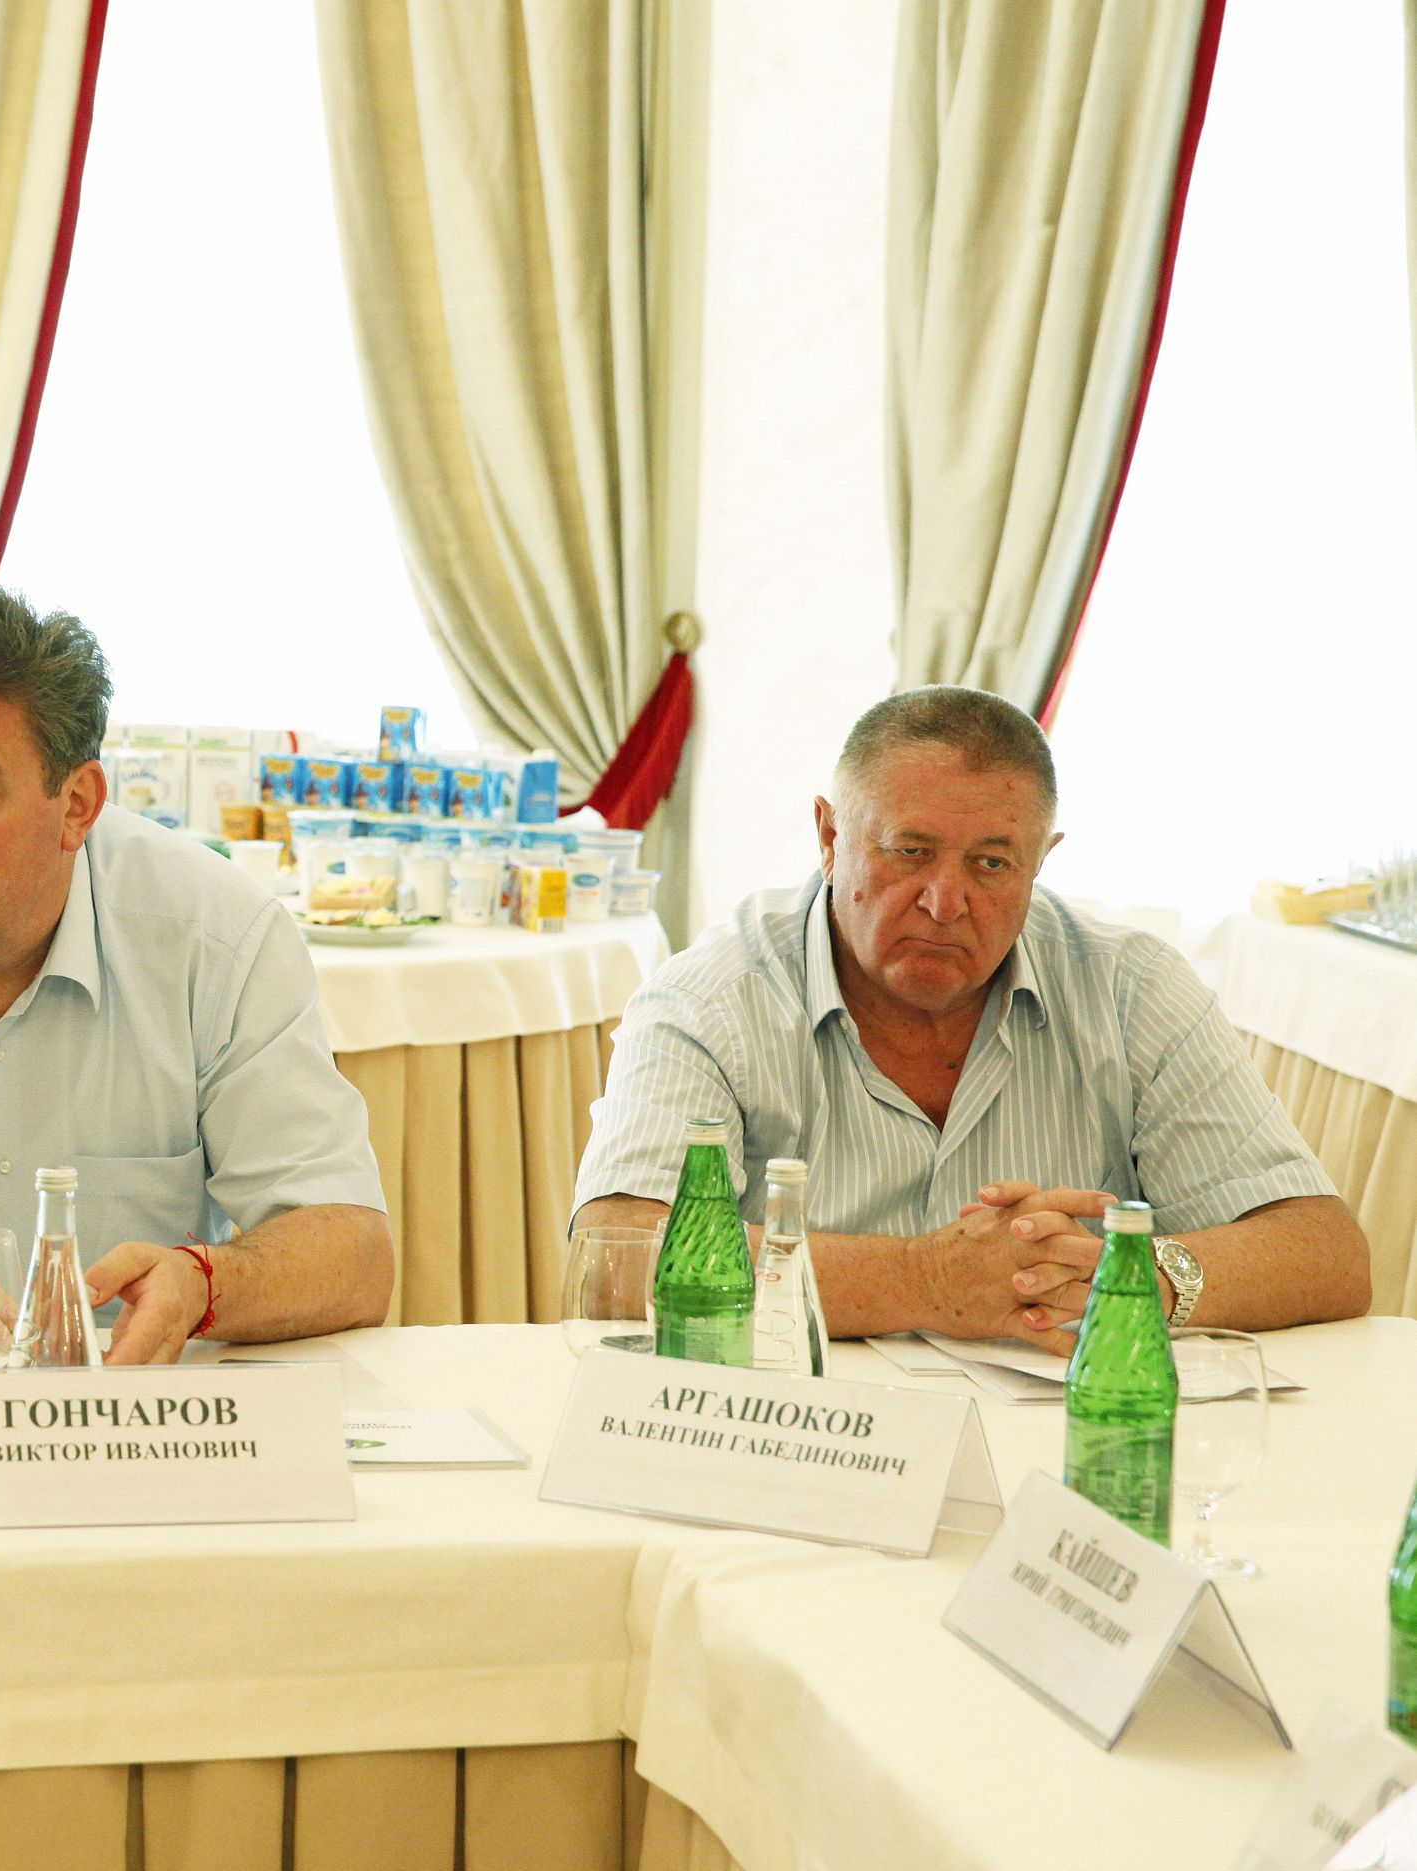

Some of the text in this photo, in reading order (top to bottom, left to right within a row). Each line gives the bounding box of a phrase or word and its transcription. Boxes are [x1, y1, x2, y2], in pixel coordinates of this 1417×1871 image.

[3, 1397, 239, 1429] ГОНЧАРОВ
[650, 1386, 874, 1437] АРГАШОКОВ
[105, 1440, 258, 1461] ИВАНОВИЧ
[600, 1416, 907, 1476] ВАЛЕНТИН ГАБЕДИНОВИЧ
[1049, 1529, 1139, 1602] КАЙШЕВ
